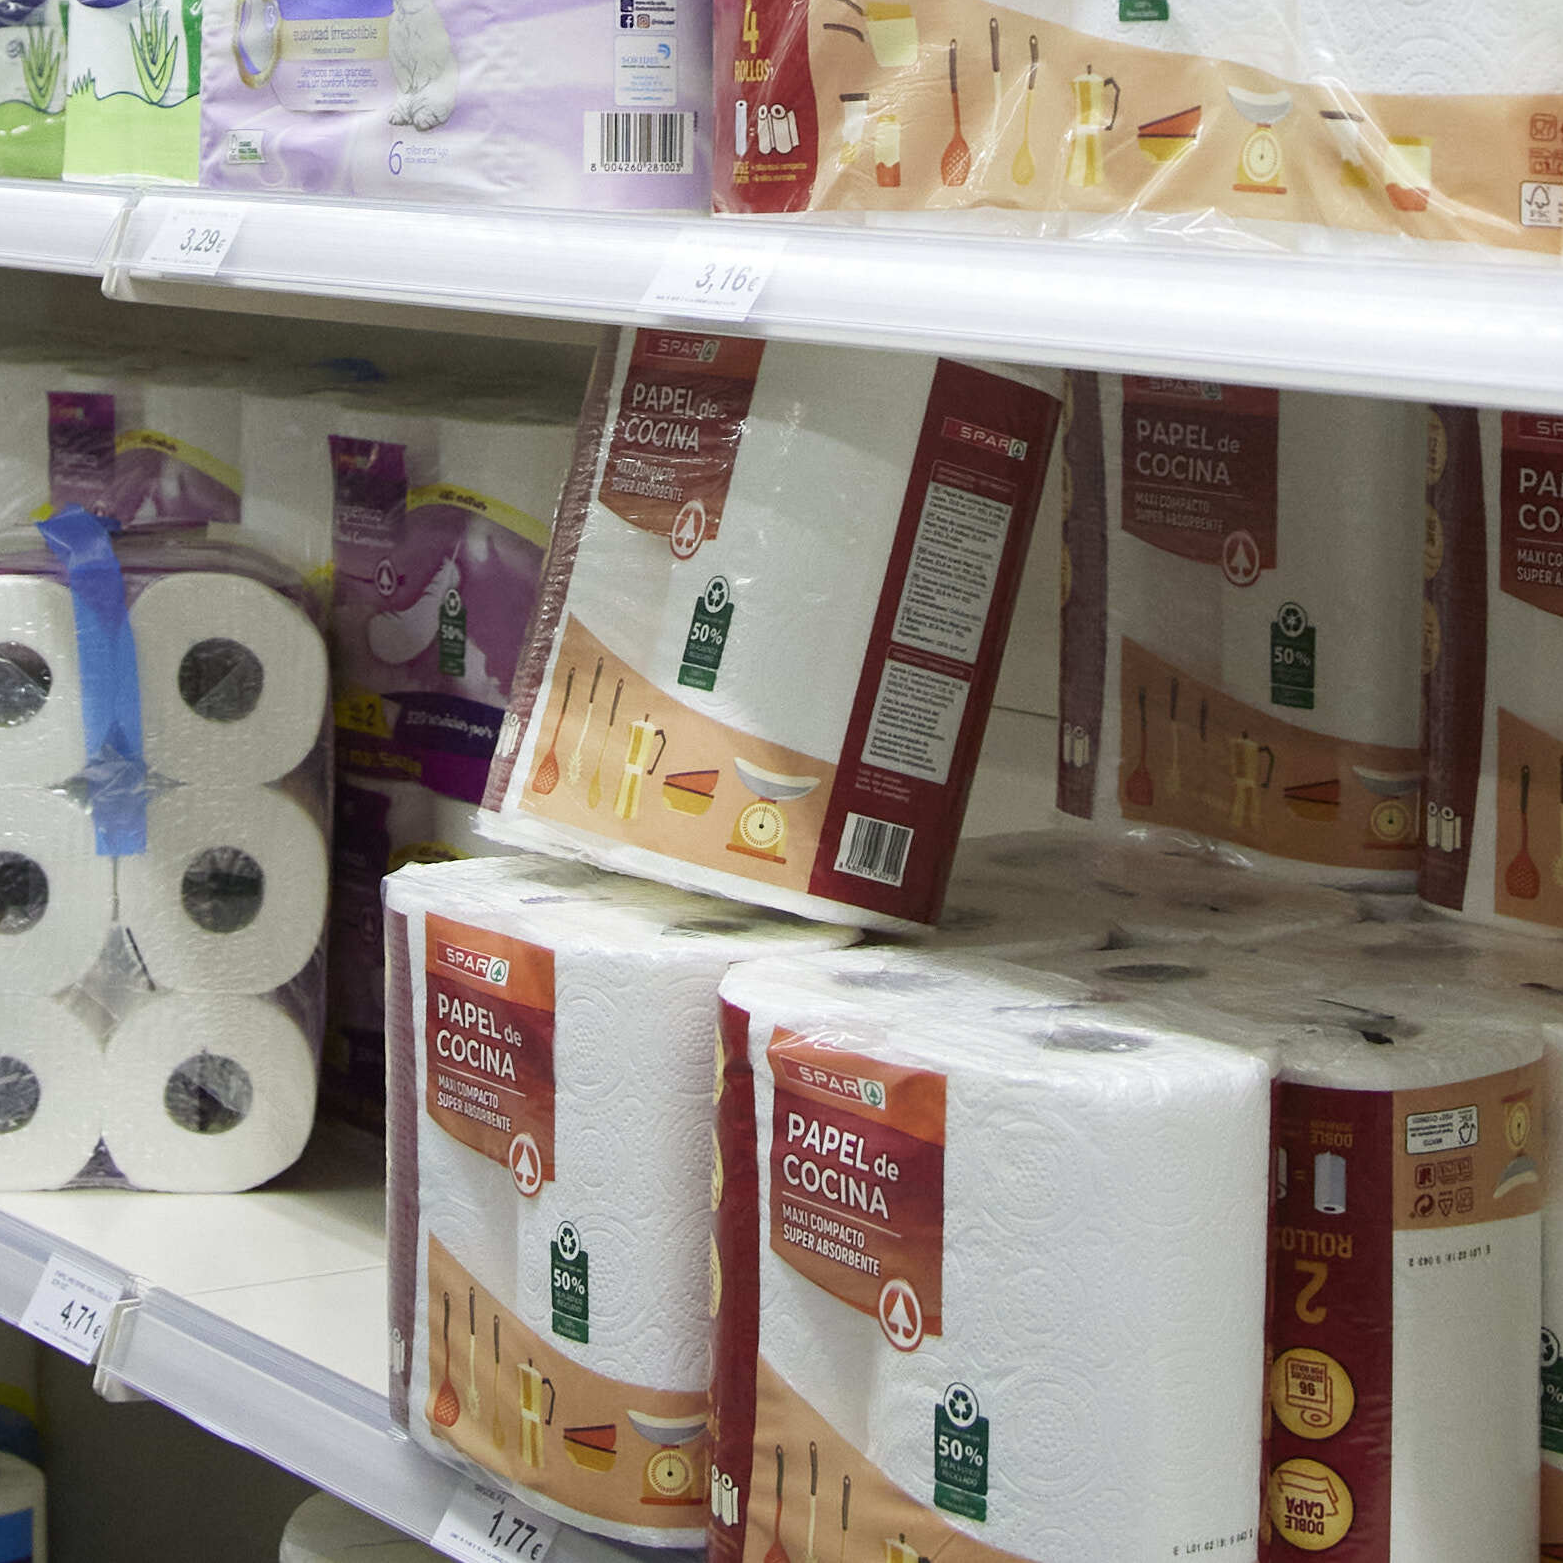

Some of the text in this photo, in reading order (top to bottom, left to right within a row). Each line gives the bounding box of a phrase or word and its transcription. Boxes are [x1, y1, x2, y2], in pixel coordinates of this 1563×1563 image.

[735, 56, 771, 84] ROLLOS
[388, 140, 404, 175] 6
[604, 163, 644, 173] 004260
[658, 338, 702, 356] SPAR
[632, 382, 718, 419] PAPEL de
[624, 417, 700, 453] COCINA
[959, 424, 1011, 452] SPAR
[1136, 418, 1241, 455] PAPEL de
[1136, 450, 1232, 487] COCINA
[1159, 494, 1211, 515] COMPACTO
[1517, 548, 1546, 566] MAXI
[1517, 566, 1553, 585] SUPER
[690, 621, 723, 645] 50%
[1273, 645, 1312, 667] 50%
[445, 947, 488, 974] SPAR
[437, 992, 524, 1048] PAPEL de
[437, 1029, 517, 1082] COCINA
[438, 1073, 499, 1110] MAXI COMPACTO
[798, 1066, 861, 1097] SPAR
[437, 1090, 512, 1134] SUPER ABSORBENTE
[786, 1112, 901, 1182] PAPEL de
[782, 1153, 890, 1221] COCINA
[782, 1203, 865, 1249] MAXI COMPACTO
[783, 1223, 881, 1277] SUPER ABSORBENTE
[553, 1268, 586, 1295] 50%
[1294, 1260, 1329, 1324] 2
[61, 1299, 102, 1341] 4,71€
[1298, 1380, 1316, 1397] 96
[938, 1434, 984, 1467] 50%
[1285, 1496, 1325, 1519] CAPA
[488, 1509, 543, 1561] 1,77€
[1284, 1514, 1325, 1536] DOBLE
